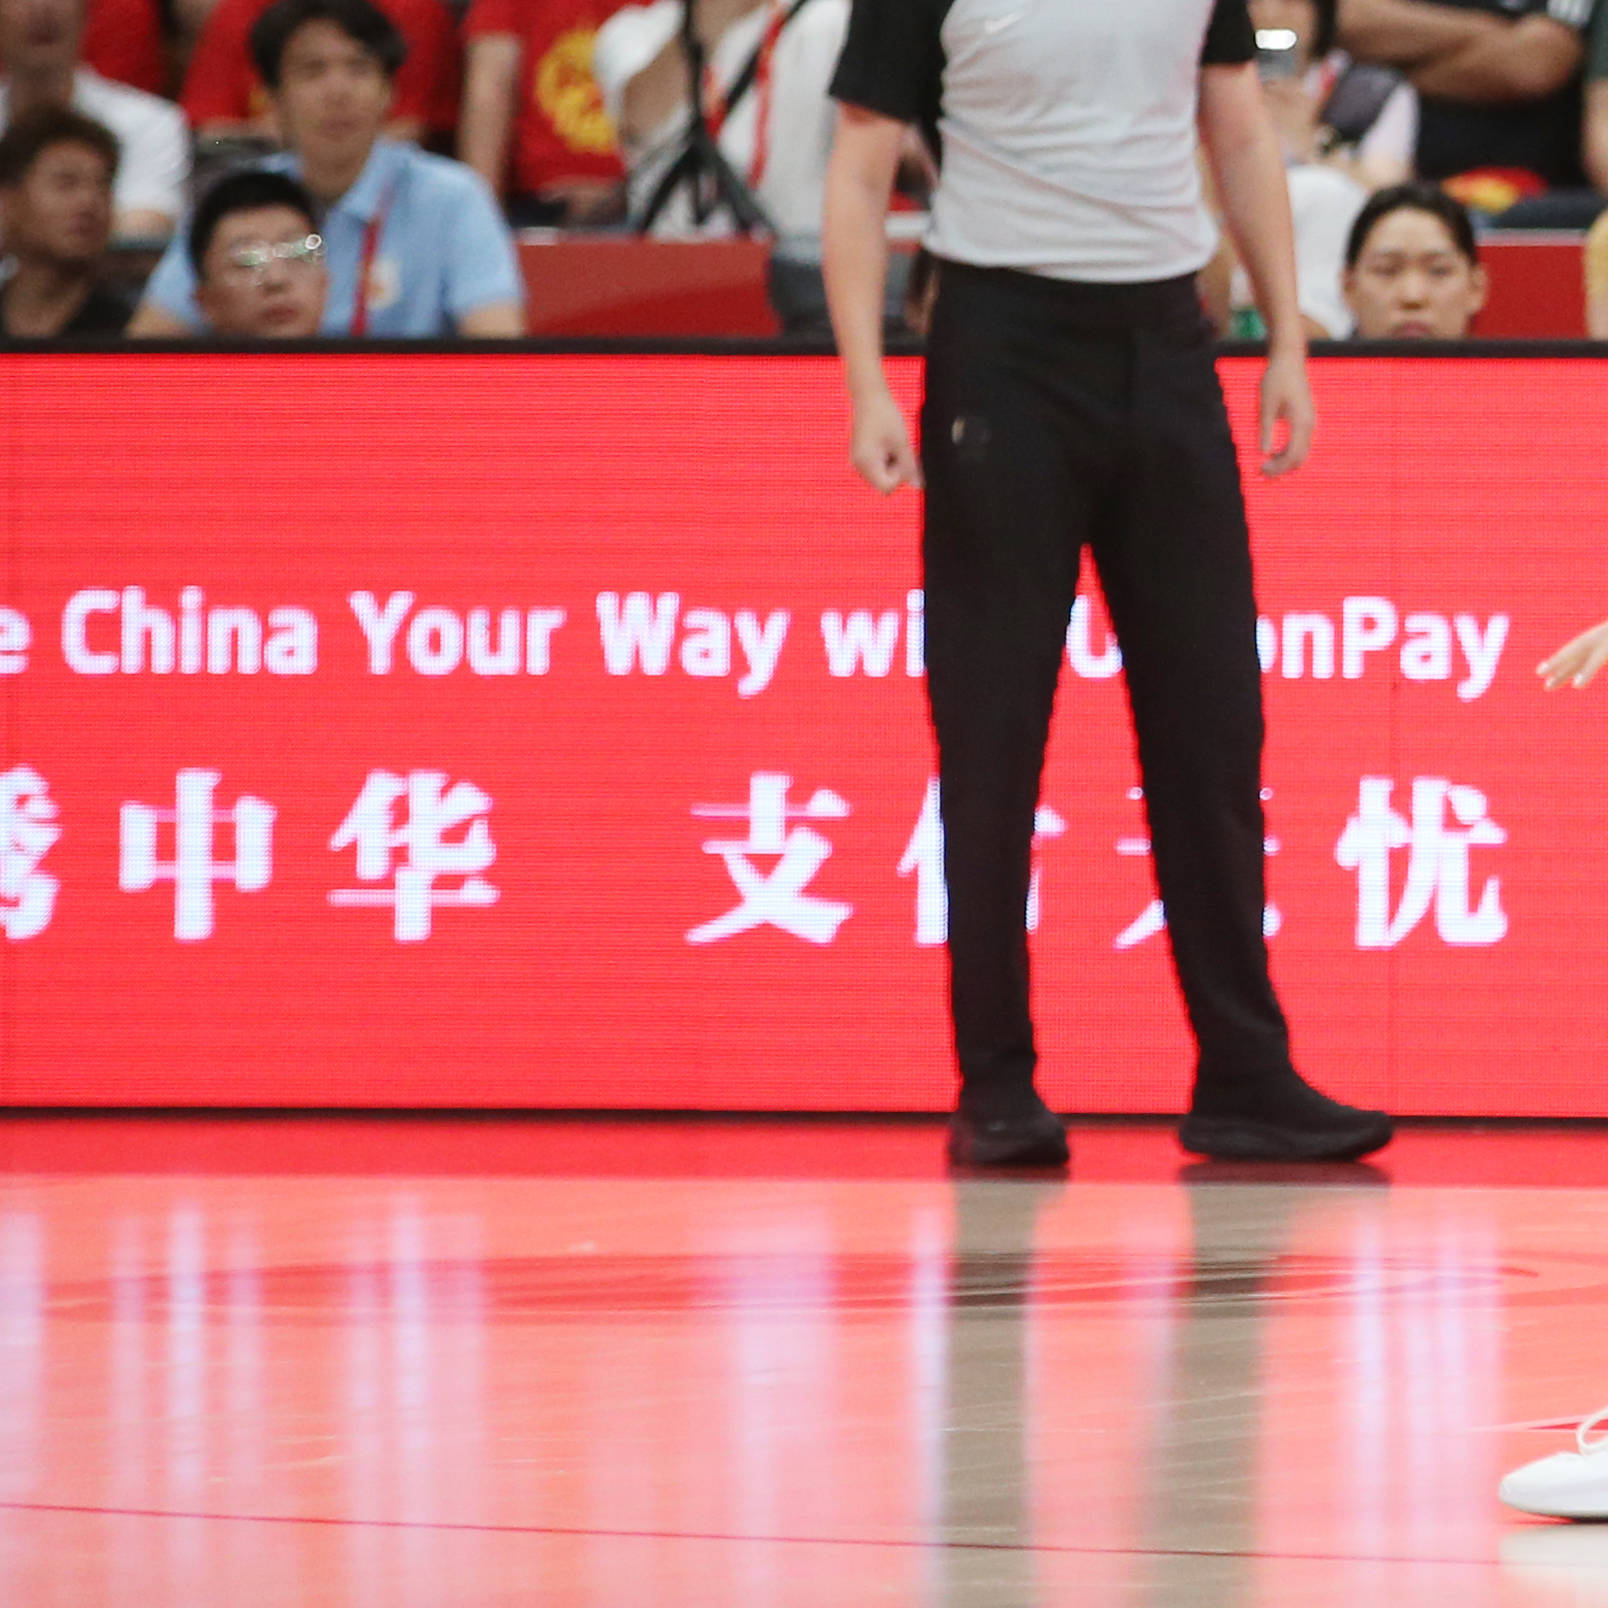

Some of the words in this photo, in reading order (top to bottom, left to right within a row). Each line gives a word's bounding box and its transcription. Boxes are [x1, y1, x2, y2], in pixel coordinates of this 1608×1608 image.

[61, 586, 319, 675] China
[350, 590, 566, 675] Your
[597, 591, 790, 697] Way
[685, 771, 1510, 949] 支忧
